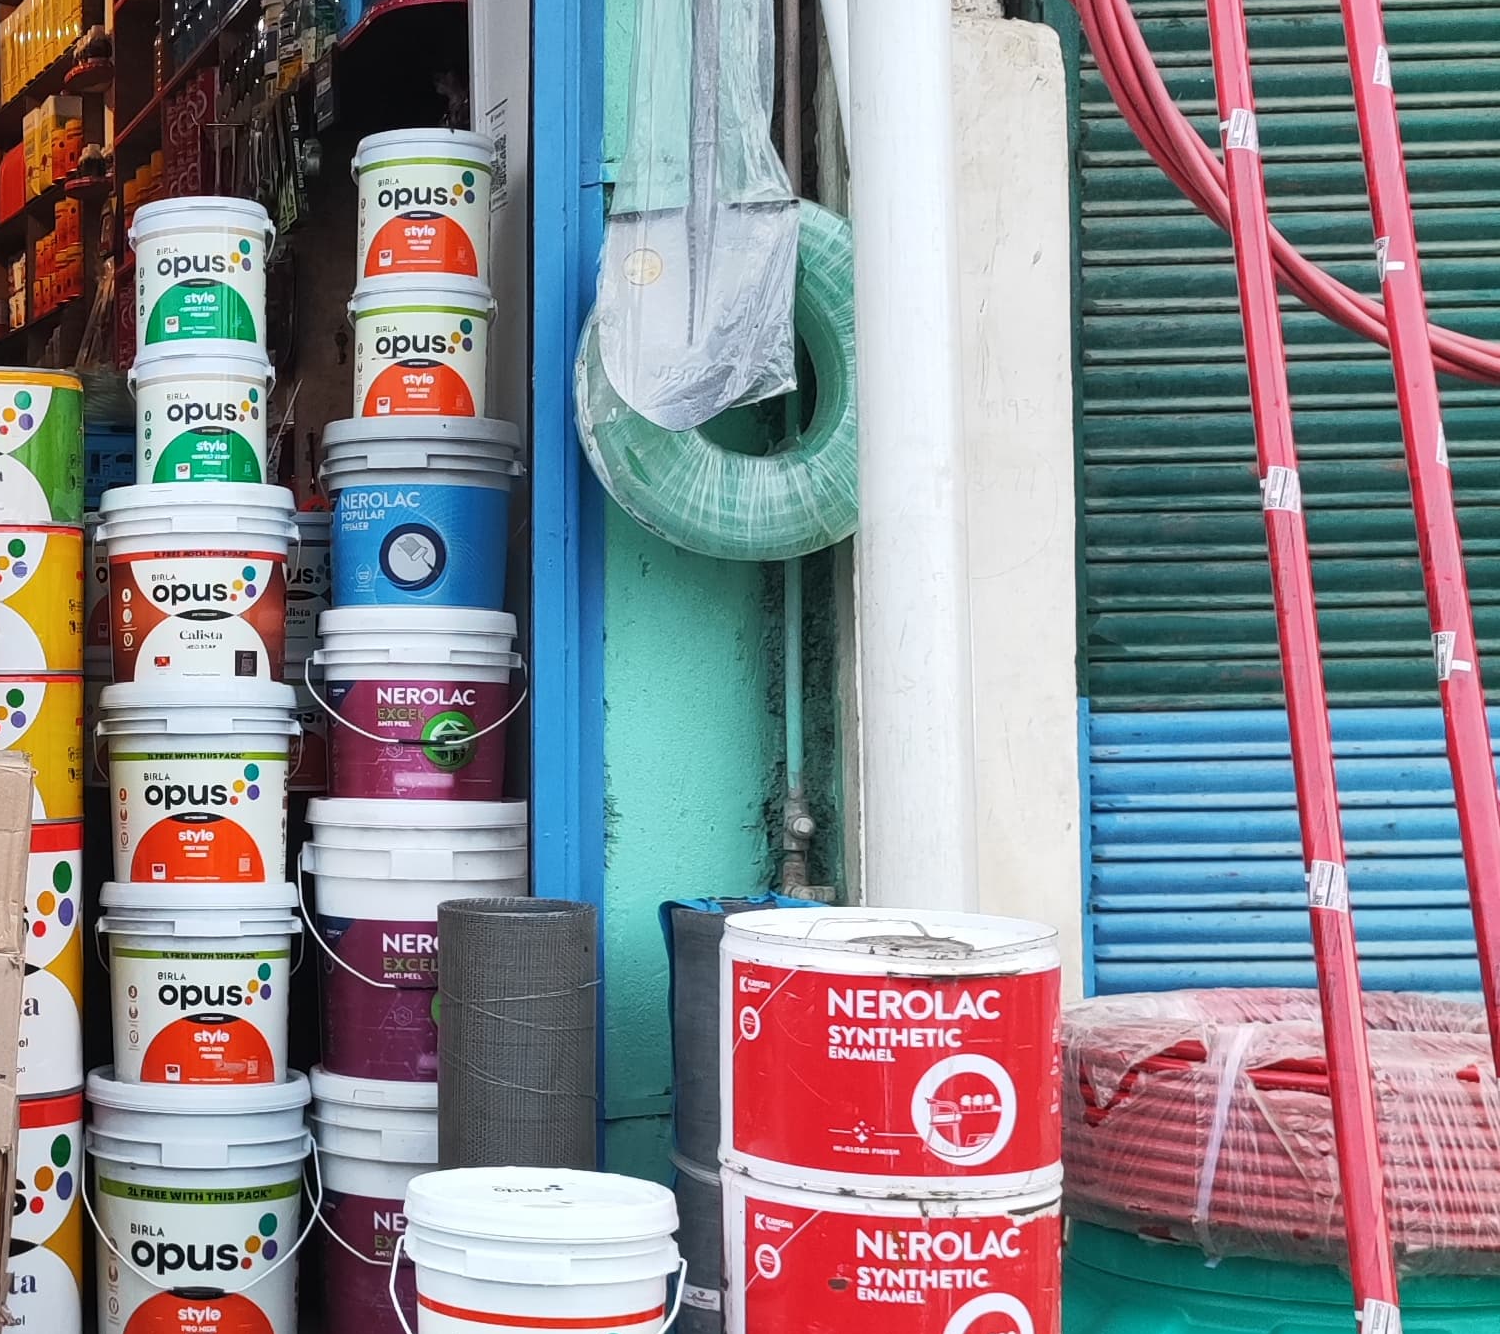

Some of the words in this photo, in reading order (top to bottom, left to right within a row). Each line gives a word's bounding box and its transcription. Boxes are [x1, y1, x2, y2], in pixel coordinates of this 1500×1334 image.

[378, 187, 448, 210] opus
[404, 225, 436, 238] style
[157, 255, 225, 278] opus
[376, 335, 446, 358] opus
[167, 402, 236, 424] opus
[341, 492, 420, 509] NEROLAC
[341, 510, 385, 520] POPULAR
[342, 522, 369, 531] PRIMER
[153, 584, 227, 606] opus
[180, 630, 223, 640] Calista
[377, 688, 475, 706] NEROLAC
[145, 785, 228, 810] opus
[178, 829, 214, 842] style
[158, 972, 186, 980] BIRLA
[159, 985, 242, 1010] opus
[828, 987, 1000, 1020] NEROLAC
[194, 1029, 230, 1044] style
[828, 1026, 962, 1048] SYNTHETIC
[828, 1046, 895, 1062] ENAMEL
[128, 1187, 138, 1196] 2L
[141, 1189, 167, 1200] FREE
[170, 1192, 203, 1201] WITH
[206, 1192, 234, 1201] THIS
[131, 1223, 164, 1237] BIRLA
[856, 1228, 1020, 1262] NEROLAC
[131, 1240, 238, 1275] opus
[857, 1267, 988, 1289] SYNTHETIC
[857, 1289, 925, 1304] ENAMEL
[178, 1307, 221, 1323] style
